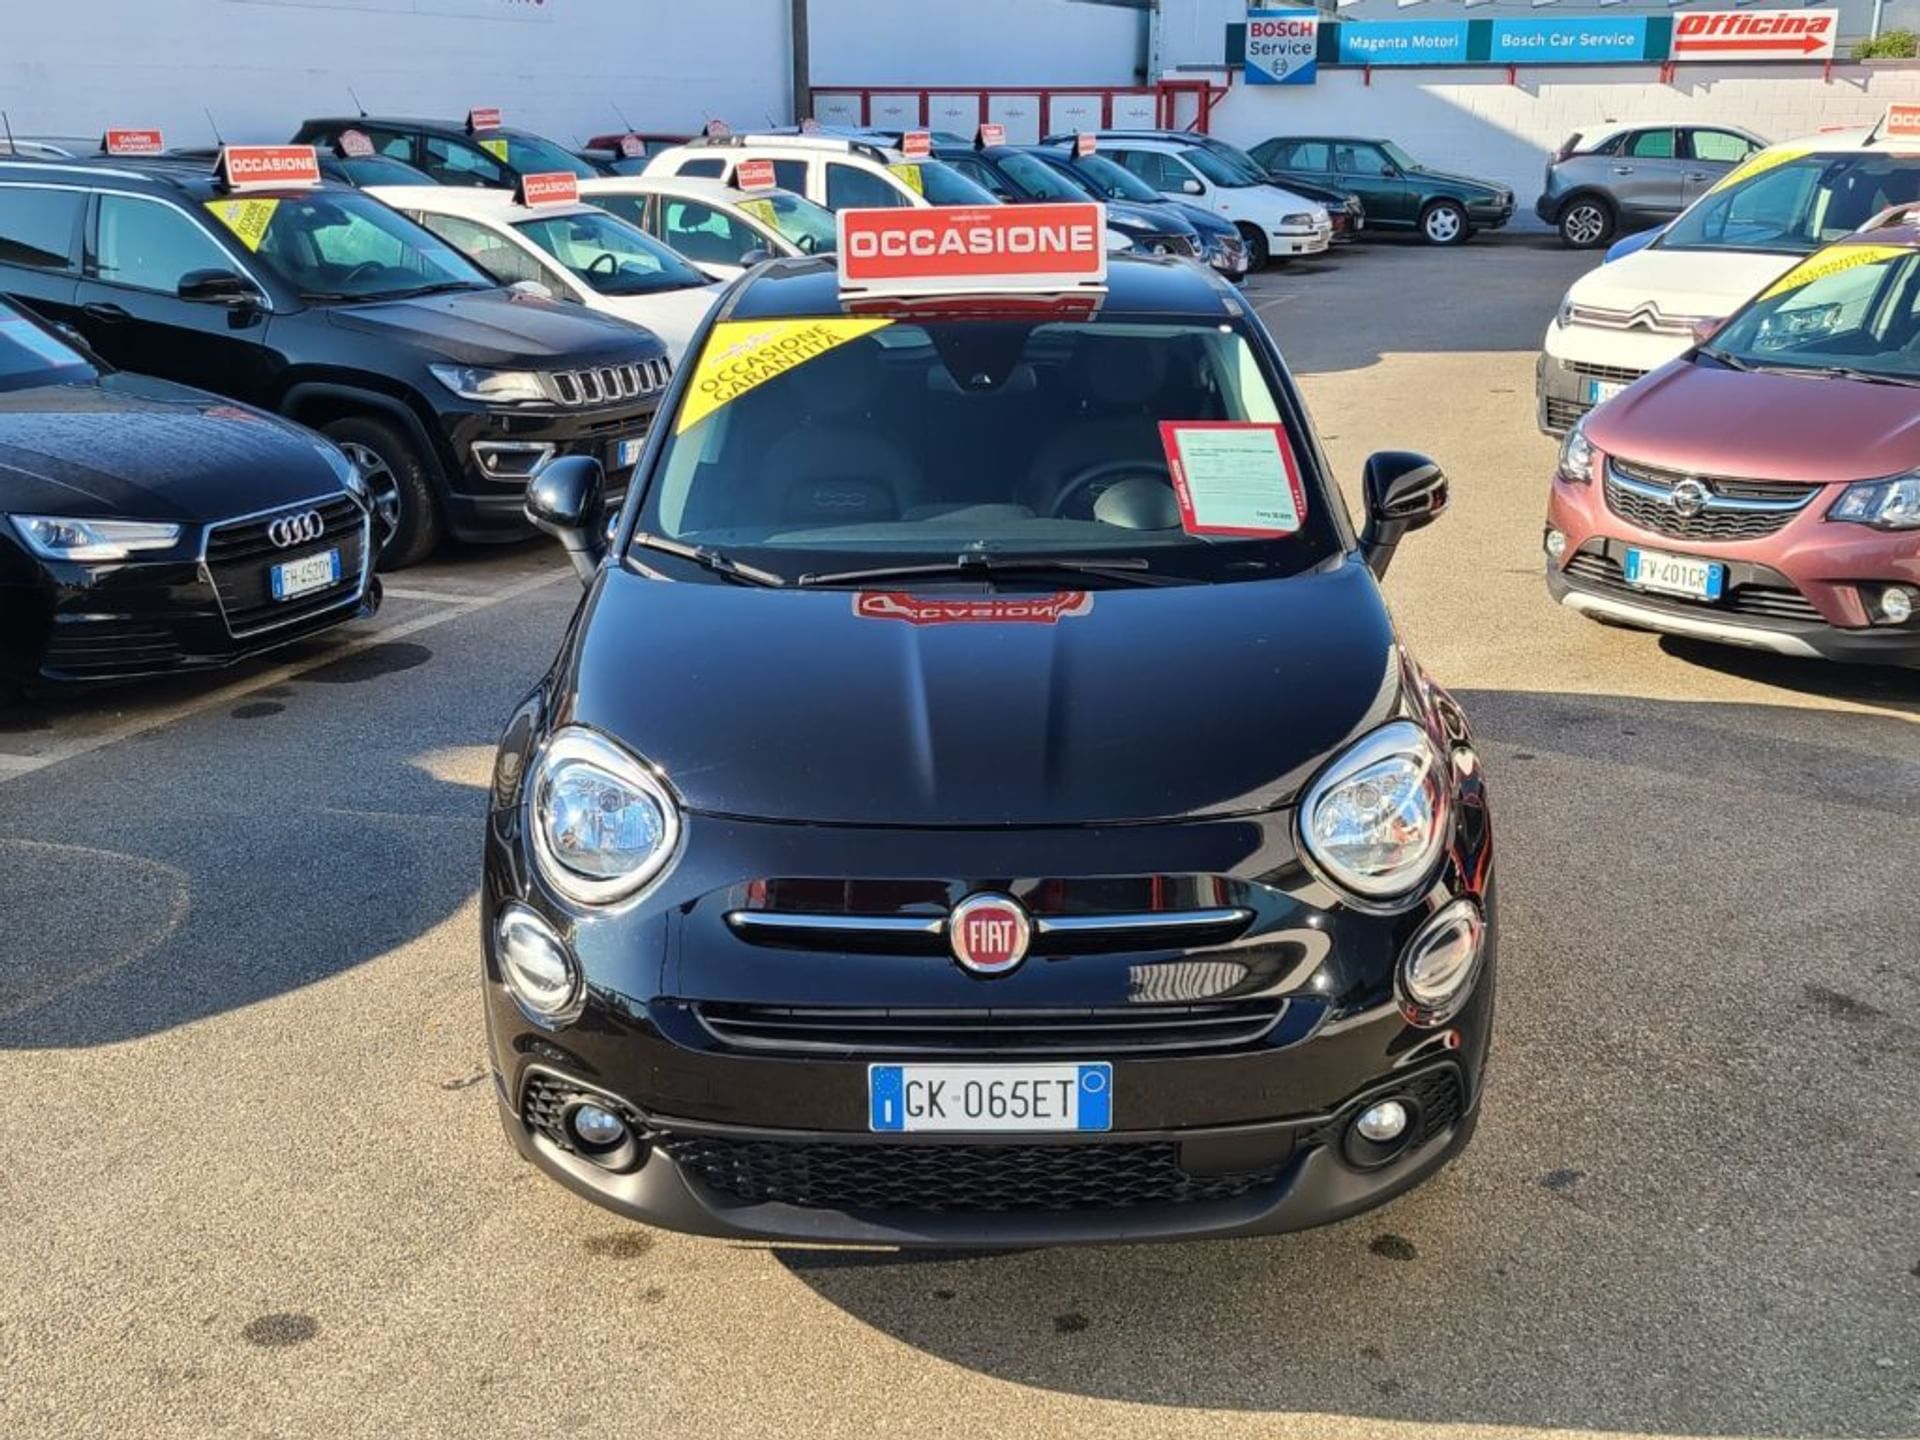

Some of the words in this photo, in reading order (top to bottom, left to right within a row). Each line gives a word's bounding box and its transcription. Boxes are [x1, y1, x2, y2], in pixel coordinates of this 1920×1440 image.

[1250, 22, 1314, 38] BOSCH
[1676, 12, 1832, 37] Officina
[1250, 40, 1312, 55] Service
[1350, 35, 1408, 50] Magenta
[1412, 34, 1459, 48] Motori
[1501, 33, 1545, 47] Bosch
[1550, 33, 1574, 46] Car
[1579, 33, 1635, 47] Service
[232, 157, 317, 173] OCCASIONE
[850, 224, 1094, 258] OCCASIONE
[700, 323, 832, 394] OCCASIONE
[713, 332, 845, 402] GARANTITA
[969, 920, 1014, 953] FIAT
[905, 1080, 946, 1118] GK
[964, 1080, 1075, 1118] 065ET
